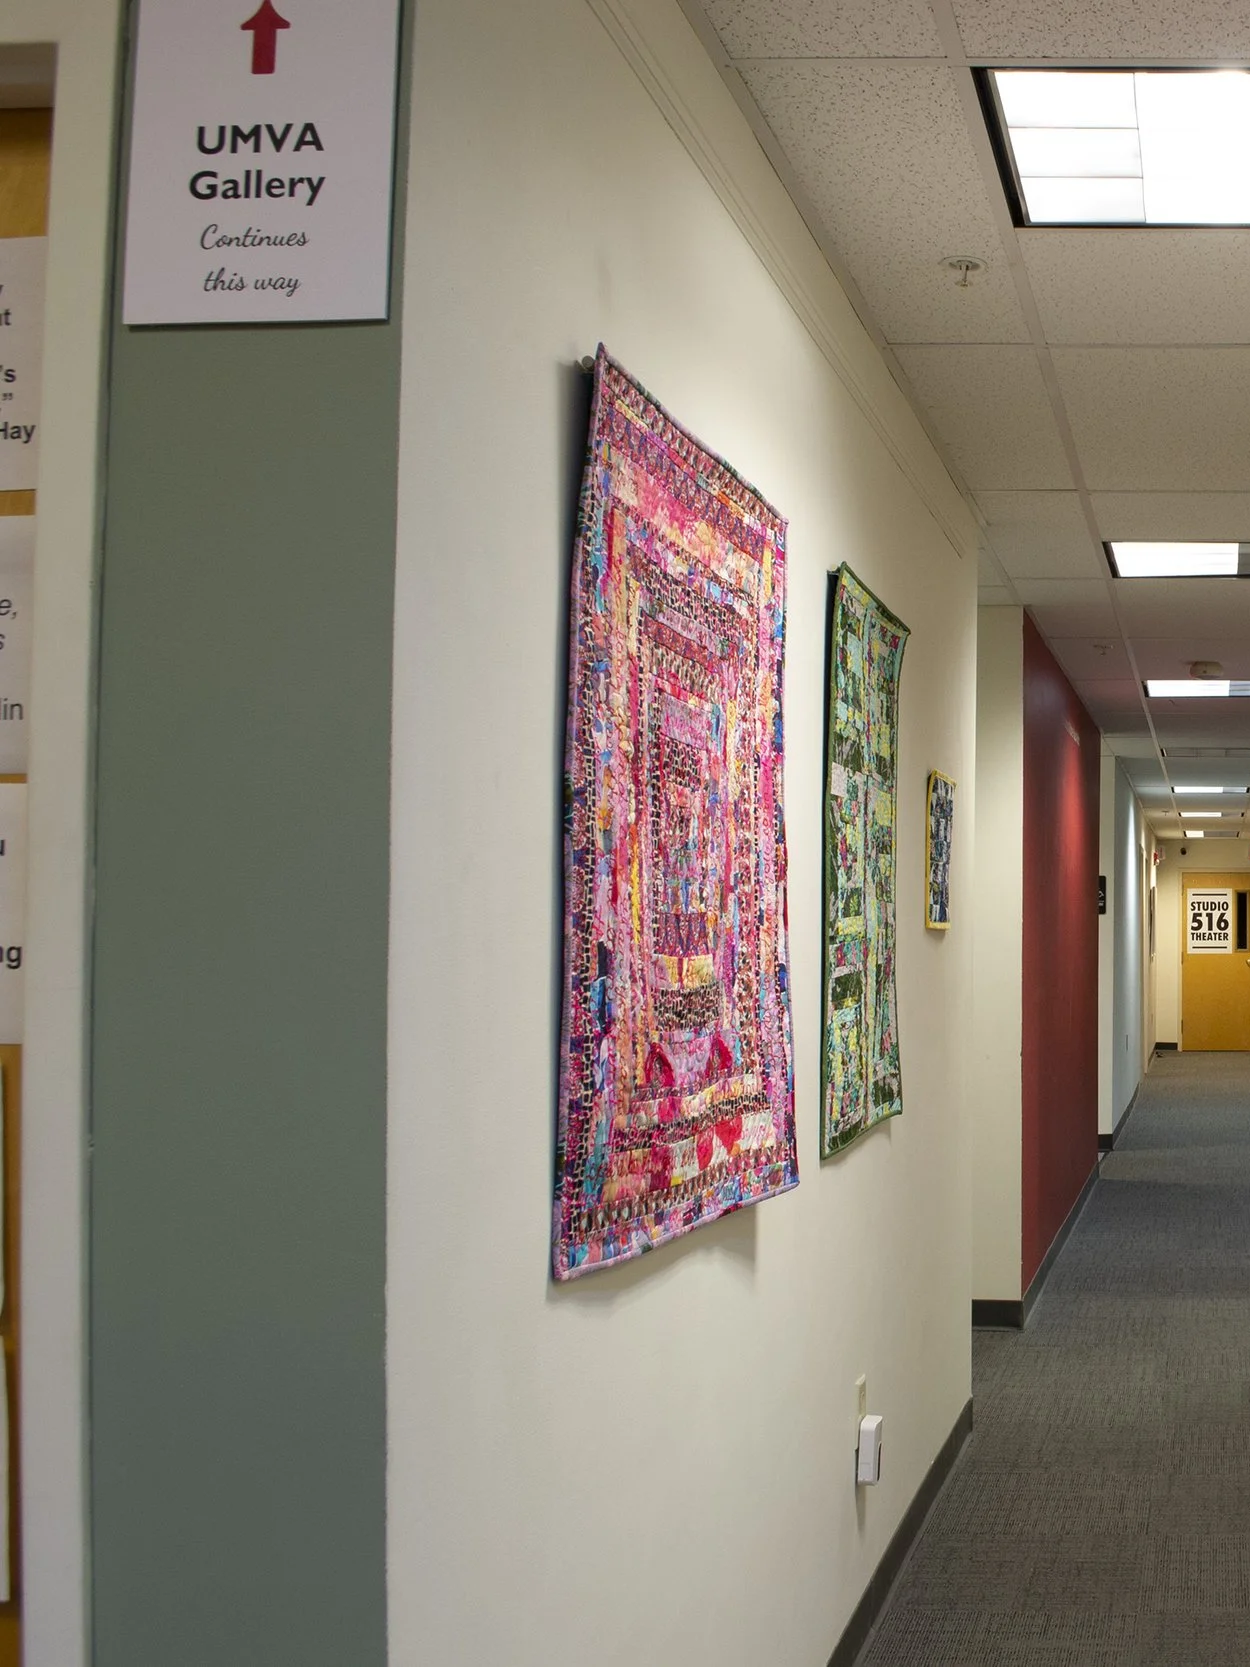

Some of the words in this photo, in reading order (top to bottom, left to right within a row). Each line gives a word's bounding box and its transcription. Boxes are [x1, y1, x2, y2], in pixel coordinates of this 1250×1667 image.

[197, 122, 324, 155] UMVA
[189, 170, 325, 206] Gallery
[200, 224, 310, 250] Continues
[203, 267, 247, 292] this
[254, 277, 302, 298] way
[1190, 901, 1229, 912] STUDIO
[1190, 912, 1229, 931] 516
[1190, 932, 1229, 941] THEATER
